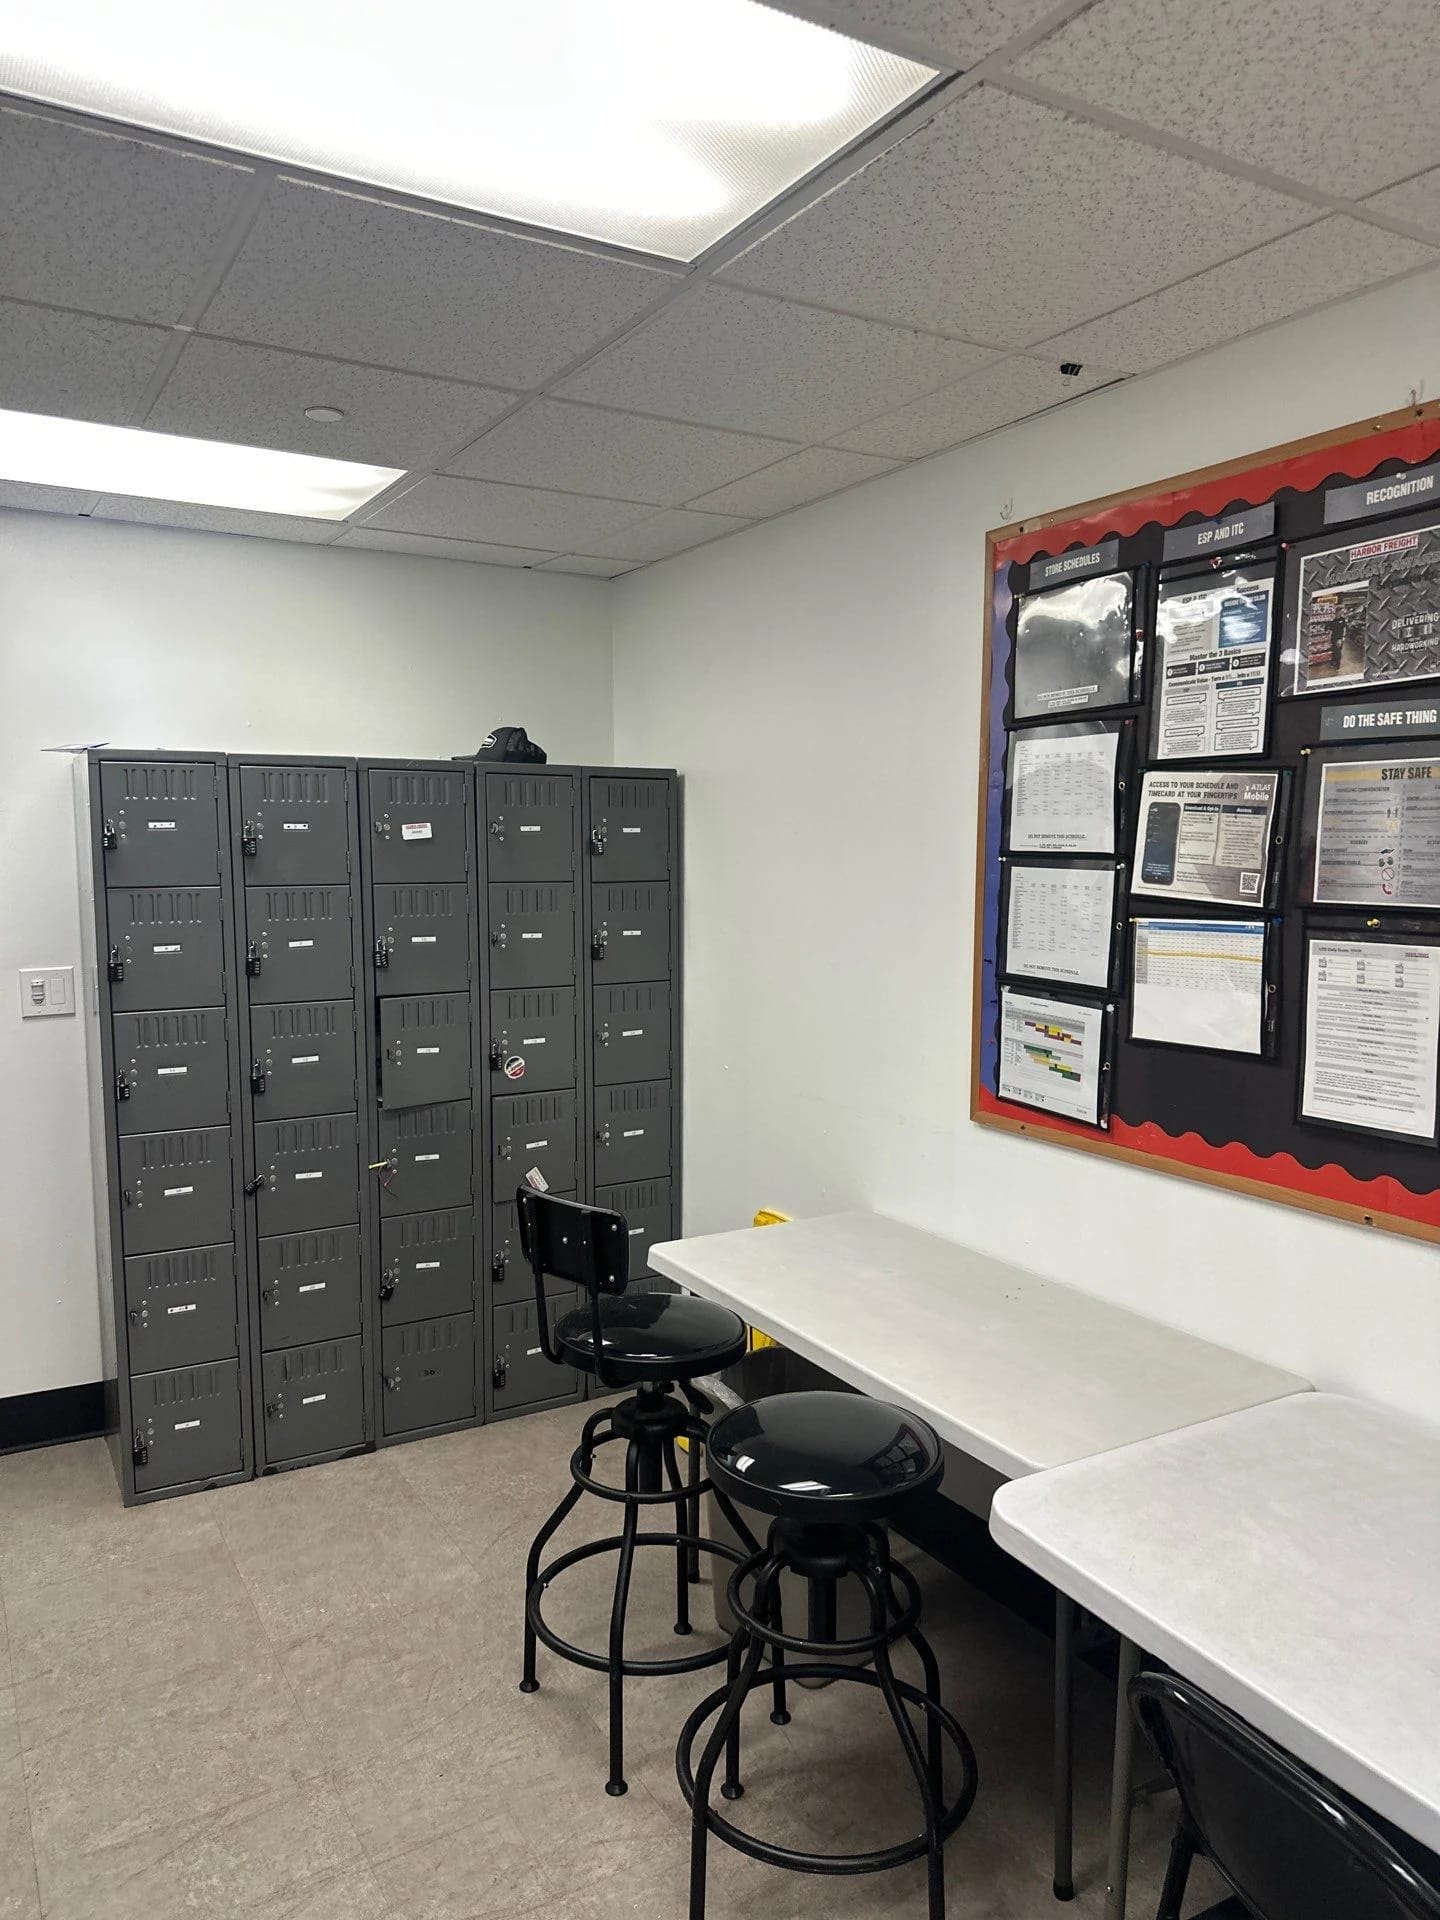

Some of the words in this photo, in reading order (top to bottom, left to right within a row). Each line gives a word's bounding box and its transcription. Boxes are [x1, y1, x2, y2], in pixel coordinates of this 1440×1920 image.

[1366, 475, 1434, 505] RECOGNITION
[1197, 531, 1213, 545] ESP
[1214, 526, 1230, 541] AND
[1231, 522, 1245, 536] ITC
[1351, 544, 1382, 558] HARBOR
[1383, 536, 1417, 551] FREIGHT
[1044, 562, 1063, 577] STORE
[1063, 552, 1100, 572] SCHEDULES
[1391, 612, 1440, 630] DELIVERING
[1391, 637, 1440, 653] HARDWORKING
[1189, 652, 1208, 661] Master
[1223, 648, 1242, 656] Basics
[1168, 679, 1196, 688] Communicate
[1343, 714, 1356, 728] DO
[1357, 713, 1376, 727] THE
[1376, 711, 1403, 726] SAFE
[1405, 709, 1438, 724] THING
[1381, 768, 1406, 781] STAY
[1407, 766, 1433, 780] SAFE
[1148, 781, 1169, 789] ACCESS
[1195, 782, 1225, 790] SCHEDULE
[1225, 782, 1239, 790] AND
[1148, 790, 1176, 798] TIMECARD
[1187, 791, 1202, 799] YOUR
[1203, 792, 1238, 800] FINGERTIPS
[1243, 791, 1270, 801] Mobile
